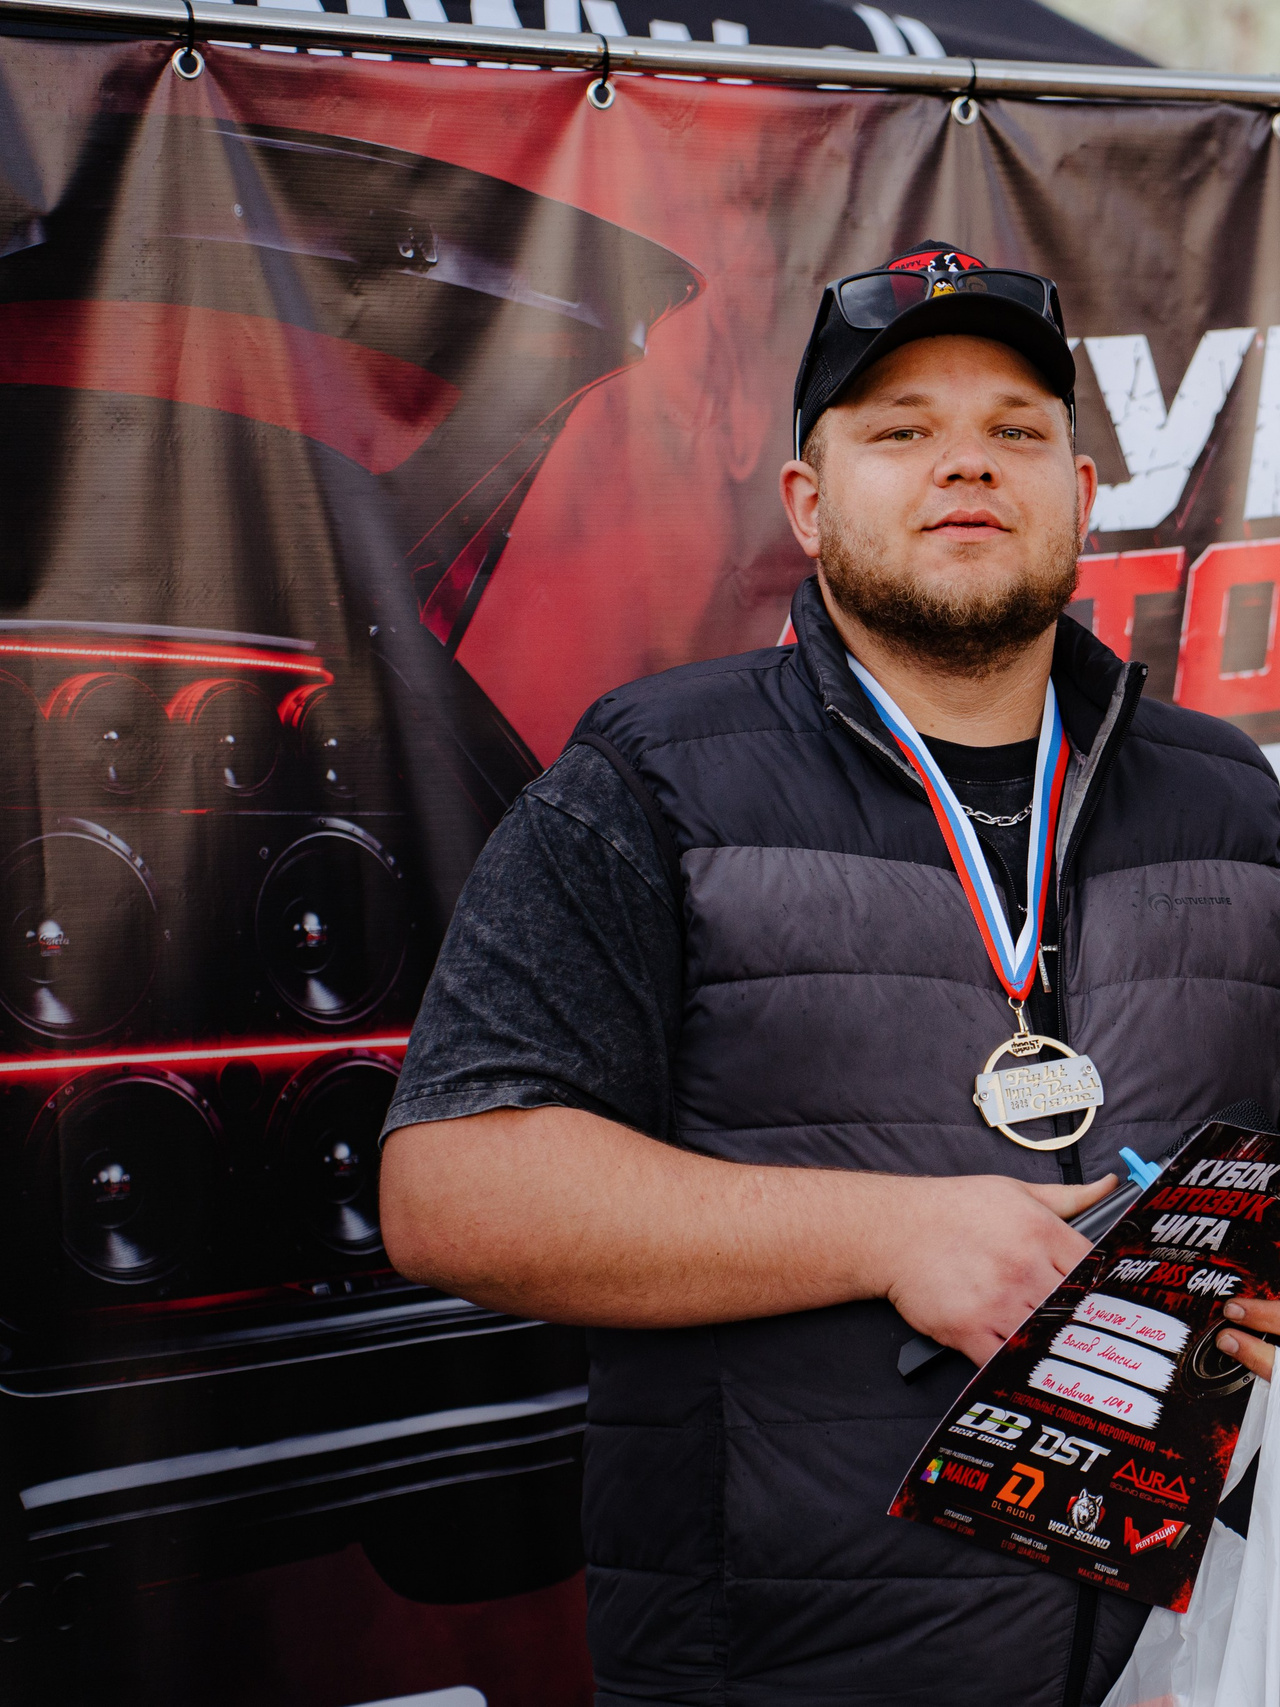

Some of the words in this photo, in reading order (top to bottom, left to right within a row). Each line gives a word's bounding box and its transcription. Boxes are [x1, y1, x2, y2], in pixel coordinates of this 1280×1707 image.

[1143, 1186, 1277, 1222] АВТОЗВУК
[1151, 1213, 1231, 1251] ЧИТА
[1150, 1247, 1200, 1263] ОТКРЫТИЕ
[1106, 1258, 1161, 1283] FIGHT
[1145, 1261, 1194, 1287] BASS
[1187, 1268, 1242, 1298] GAME
[1009, 1391, 1057, 1415] ГЕНЕРАЛЬНЫЕ
[1055, 1406, 1097, 1431] СПОНСОРЫ
[1097, 1420, 1157, 1453] МЕРОПРИЯТИЯ
[1029, 1424, 1112, 1473] DST
[941, 1461, 990, 1492] МАКСИ
[1112, 1458, 1190, 1504] AURA
[991, 1500, 1002, 1511] DL
[1006, 1503, 1036, 1522] AUDIO
[1109, 1480, 1138, 1498] SOUND
[1139, 1492, 1188, 1512] EQUIPMENT
[1135, 1524, 1178, 1550] РЕПУТАЦИЯ
[1077, 1567, 1104, 1582] МАКСИМ
[1105, 1576, 1130, 1592] ВОЛКОВ
